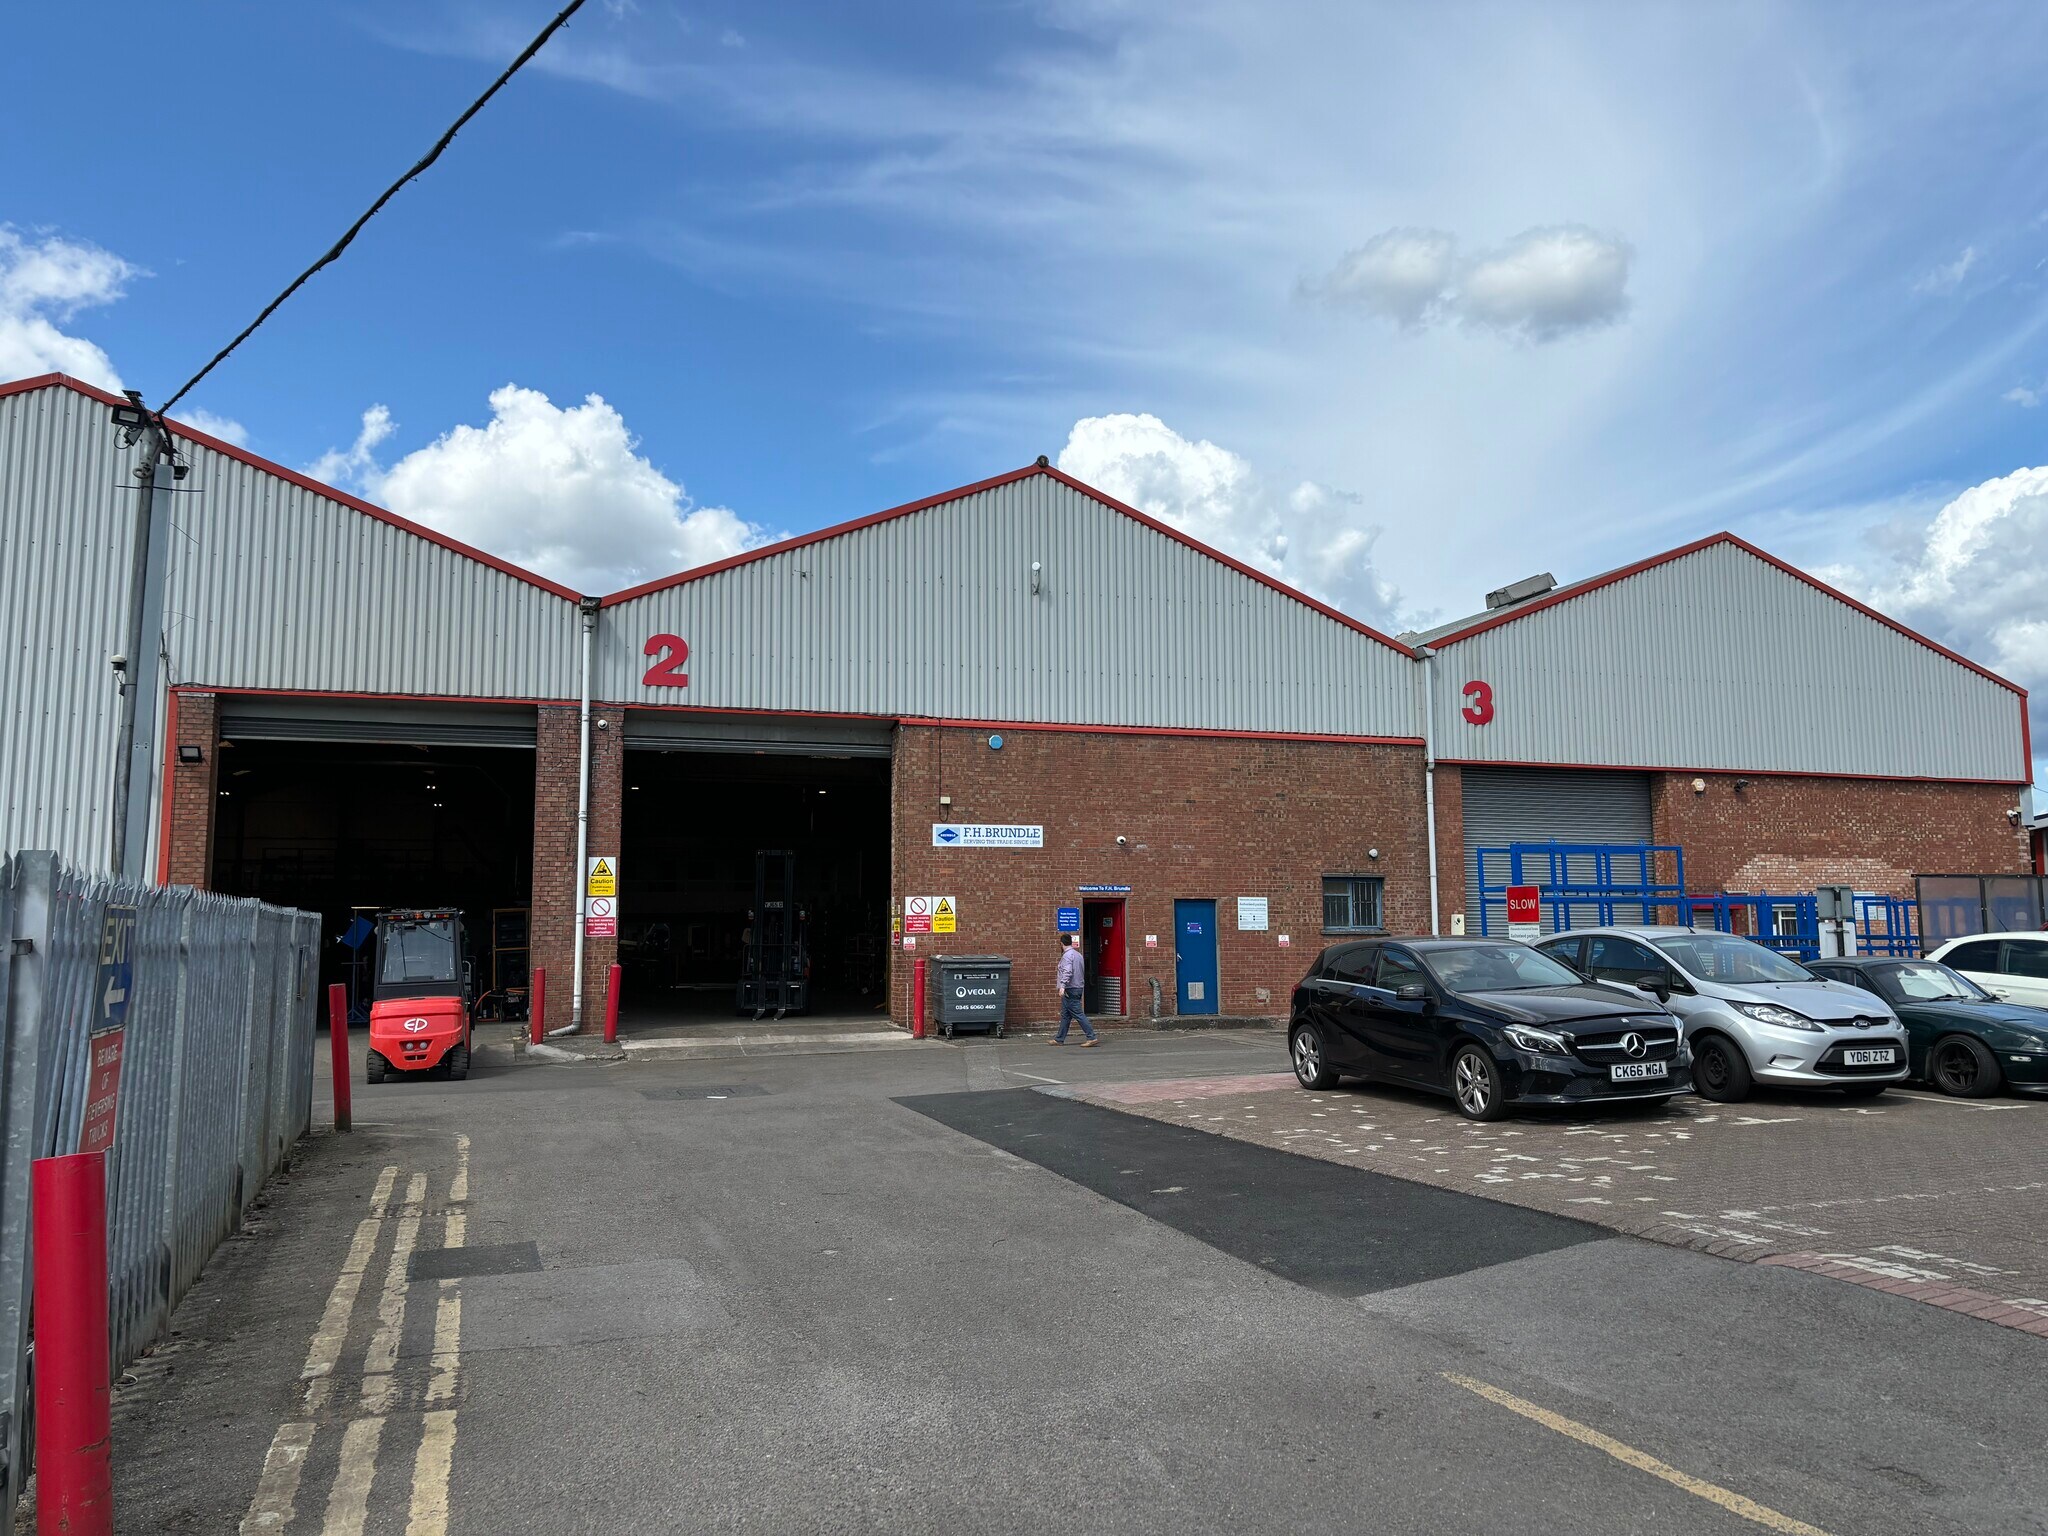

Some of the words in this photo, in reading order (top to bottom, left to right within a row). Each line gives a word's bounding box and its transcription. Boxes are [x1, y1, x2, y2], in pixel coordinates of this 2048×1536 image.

[642, 634, 688, 687] 2
[1461, 680, 1494, 725] 3
[1510, 899, 1536, 909] SLOW
[102, 918, 135, 965] EXIT
[404, 1018, 428, 1033] EP
[97, 1043, 118, 1067] BEWARE
[1850, 1051, 1871, 1063] YD61
[1873, 1050, 1890, 1062] ZTZ
[1615, 1064, 1643, 1078] CK66
[1645, 1062, 1664, 1076] WGA
[101, 1071, 110, 1091] OF
